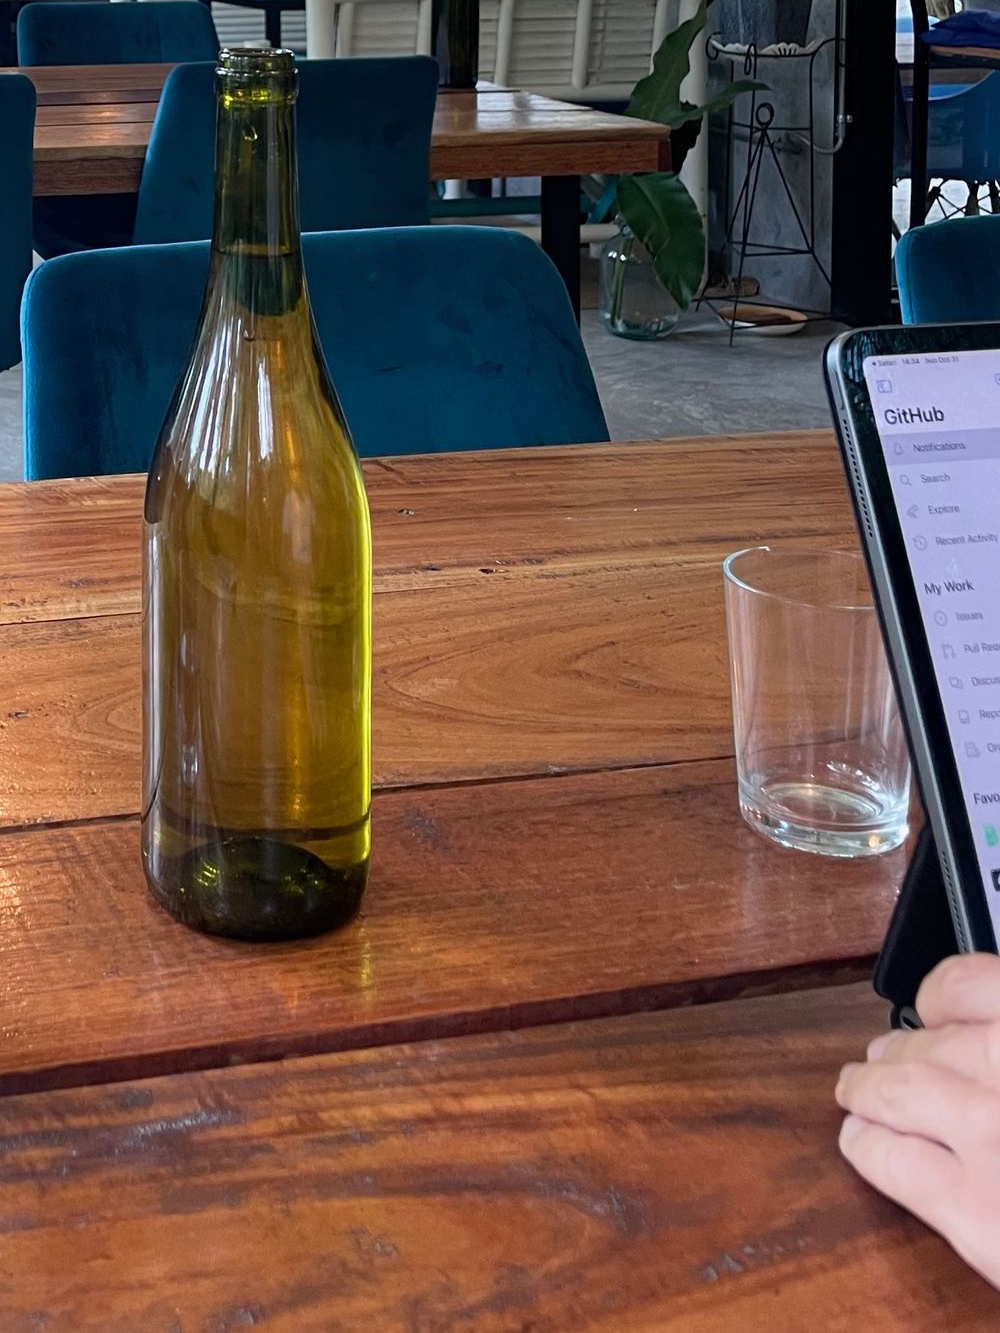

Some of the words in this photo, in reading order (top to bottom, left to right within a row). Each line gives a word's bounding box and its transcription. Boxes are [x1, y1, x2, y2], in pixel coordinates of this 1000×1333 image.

[884, 406, 945, 426] GitHub
[912, 441, 966, 454] Notifications
[920, 473, 951, 484] Search
[927, 504, 960, 516] Explore
[935, 535, 966, 546] Recent
[967, 532, 999, 545] Activity
[924, 581, 942, 596] My
[944, 579, 974, 593] Work
[973, 791, 1000, 806] Favo
